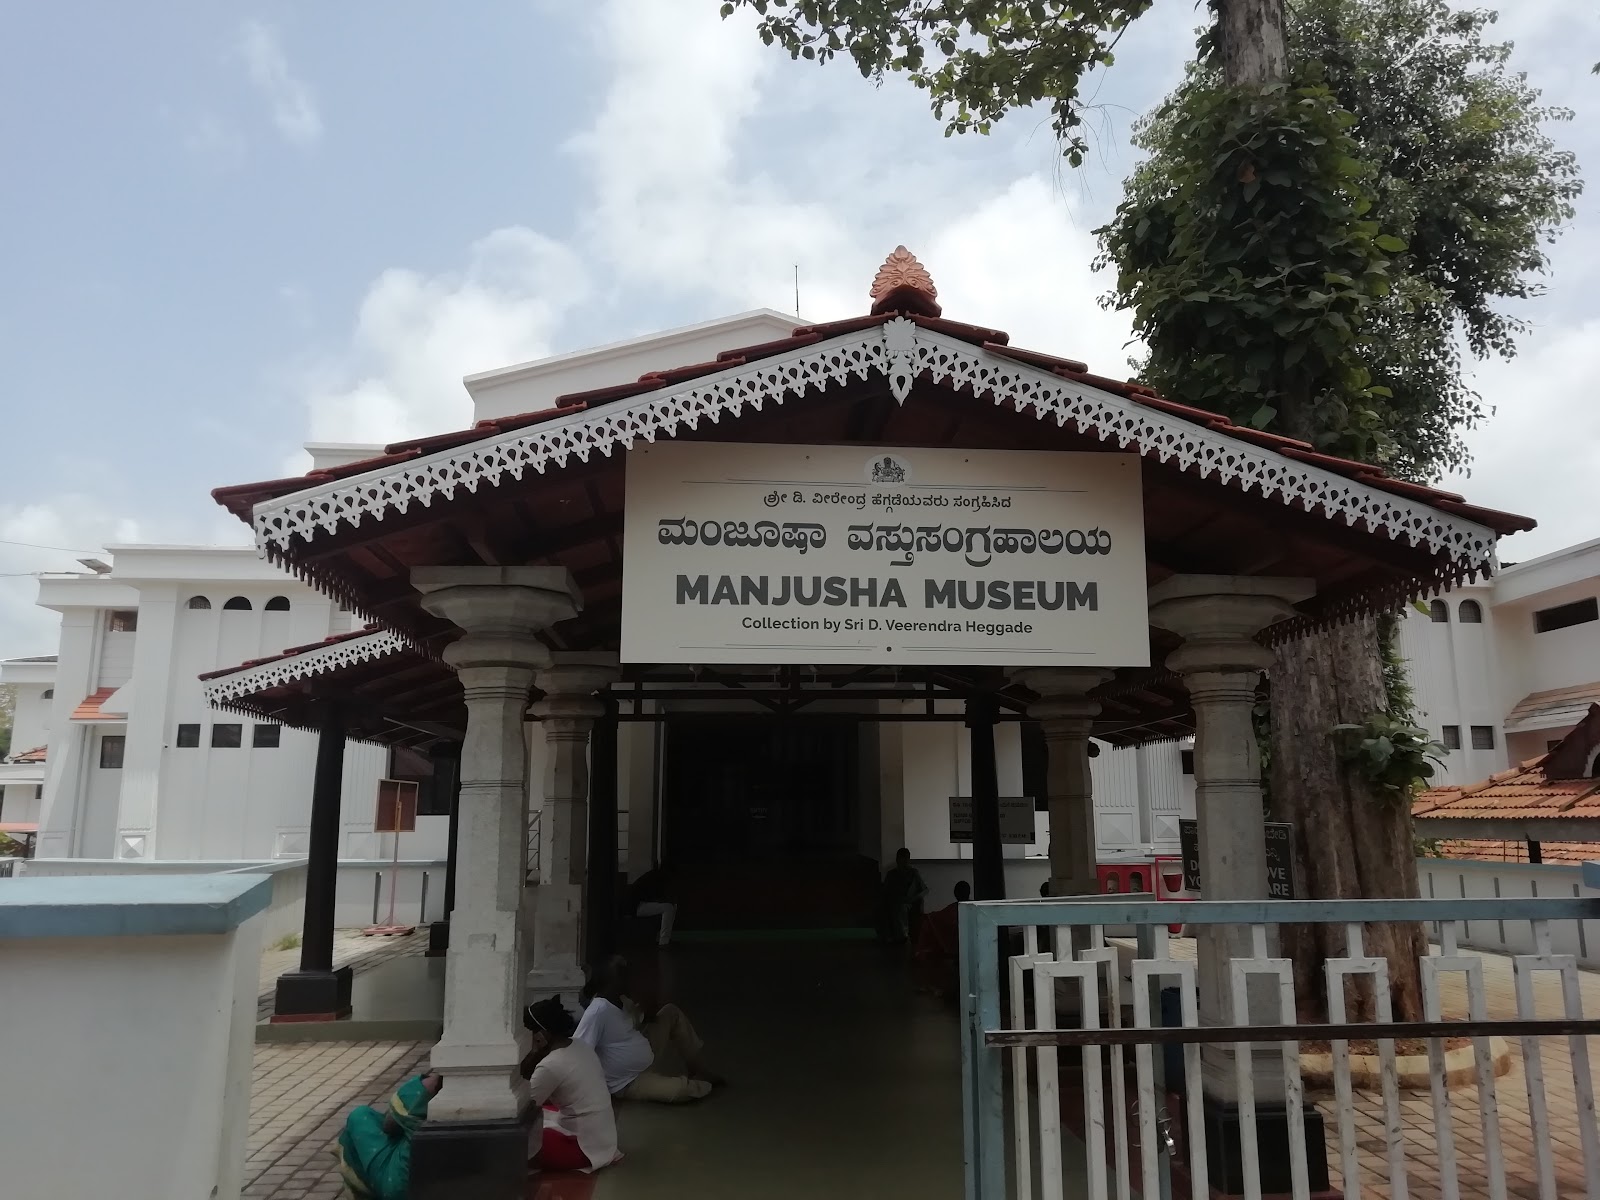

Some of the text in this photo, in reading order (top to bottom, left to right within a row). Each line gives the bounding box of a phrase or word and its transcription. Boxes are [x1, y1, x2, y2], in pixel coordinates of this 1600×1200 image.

[812, 492, 866, 510] ವೀರೇಂದ್ರ
[871, 493, 949, 513] ಹೆಗ್ಗಡೆಯವರು
[953, 495, 1012, 512] ಸಂಗ್ರಹಿಸಿದ
[658, 516, 1112, 567] ಮಂಜೂಷಾ ವಸ್ತುಸಂಗ್ರಹಾಲಯ
[676, 574, 1099, 612] MANJUSHA MUSEUM
[742, 617, 1033, 637] Collection by Sri D. Veerendra Heggade
[1267, 866, 1286, 880] VE
